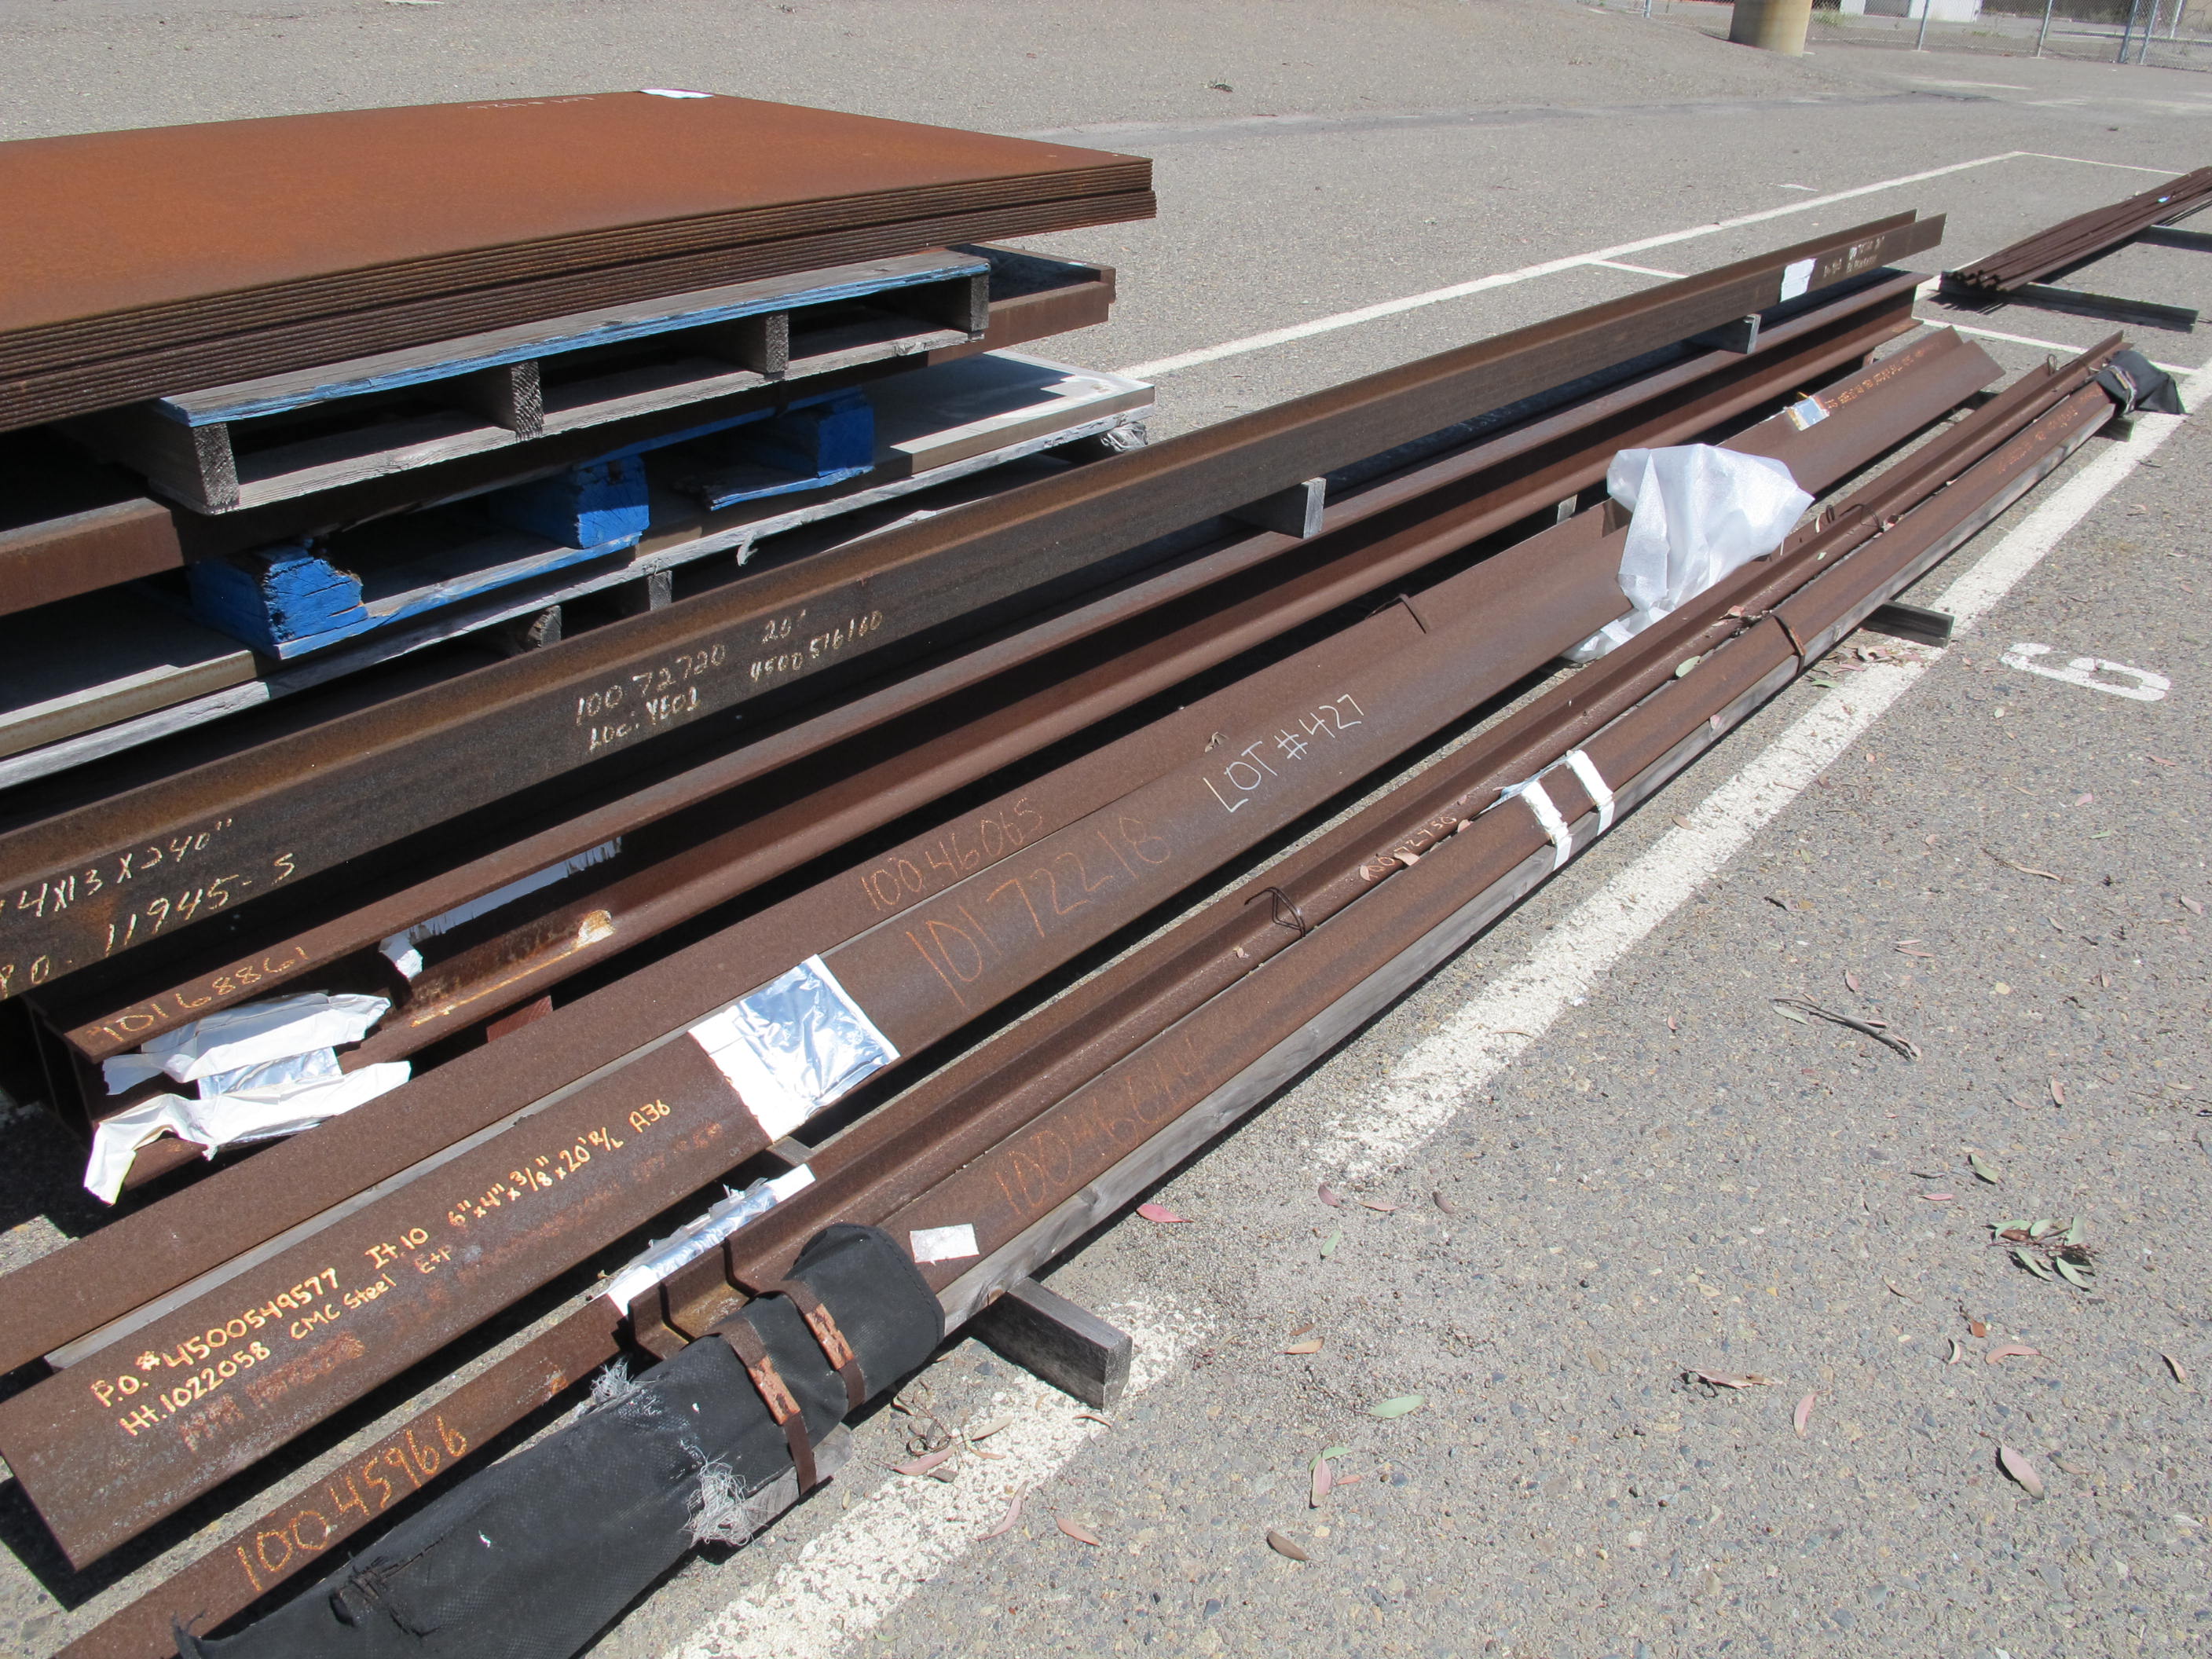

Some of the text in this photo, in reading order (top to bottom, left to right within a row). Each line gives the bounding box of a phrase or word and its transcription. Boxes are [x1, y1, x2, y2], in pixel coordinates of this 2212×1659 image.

[1203, 694, 1364, 813] LOT #427
[861, 797, 1043, 911] 10046065
[905, 817, 1171, 1007] 10172218
[628, 1099, 671, 1133] A36
[290, 1303, 341, 1340] CMC
[343, 1273, 397, 1309] Steel
[237, 1414, 467, 1592] 10045966
